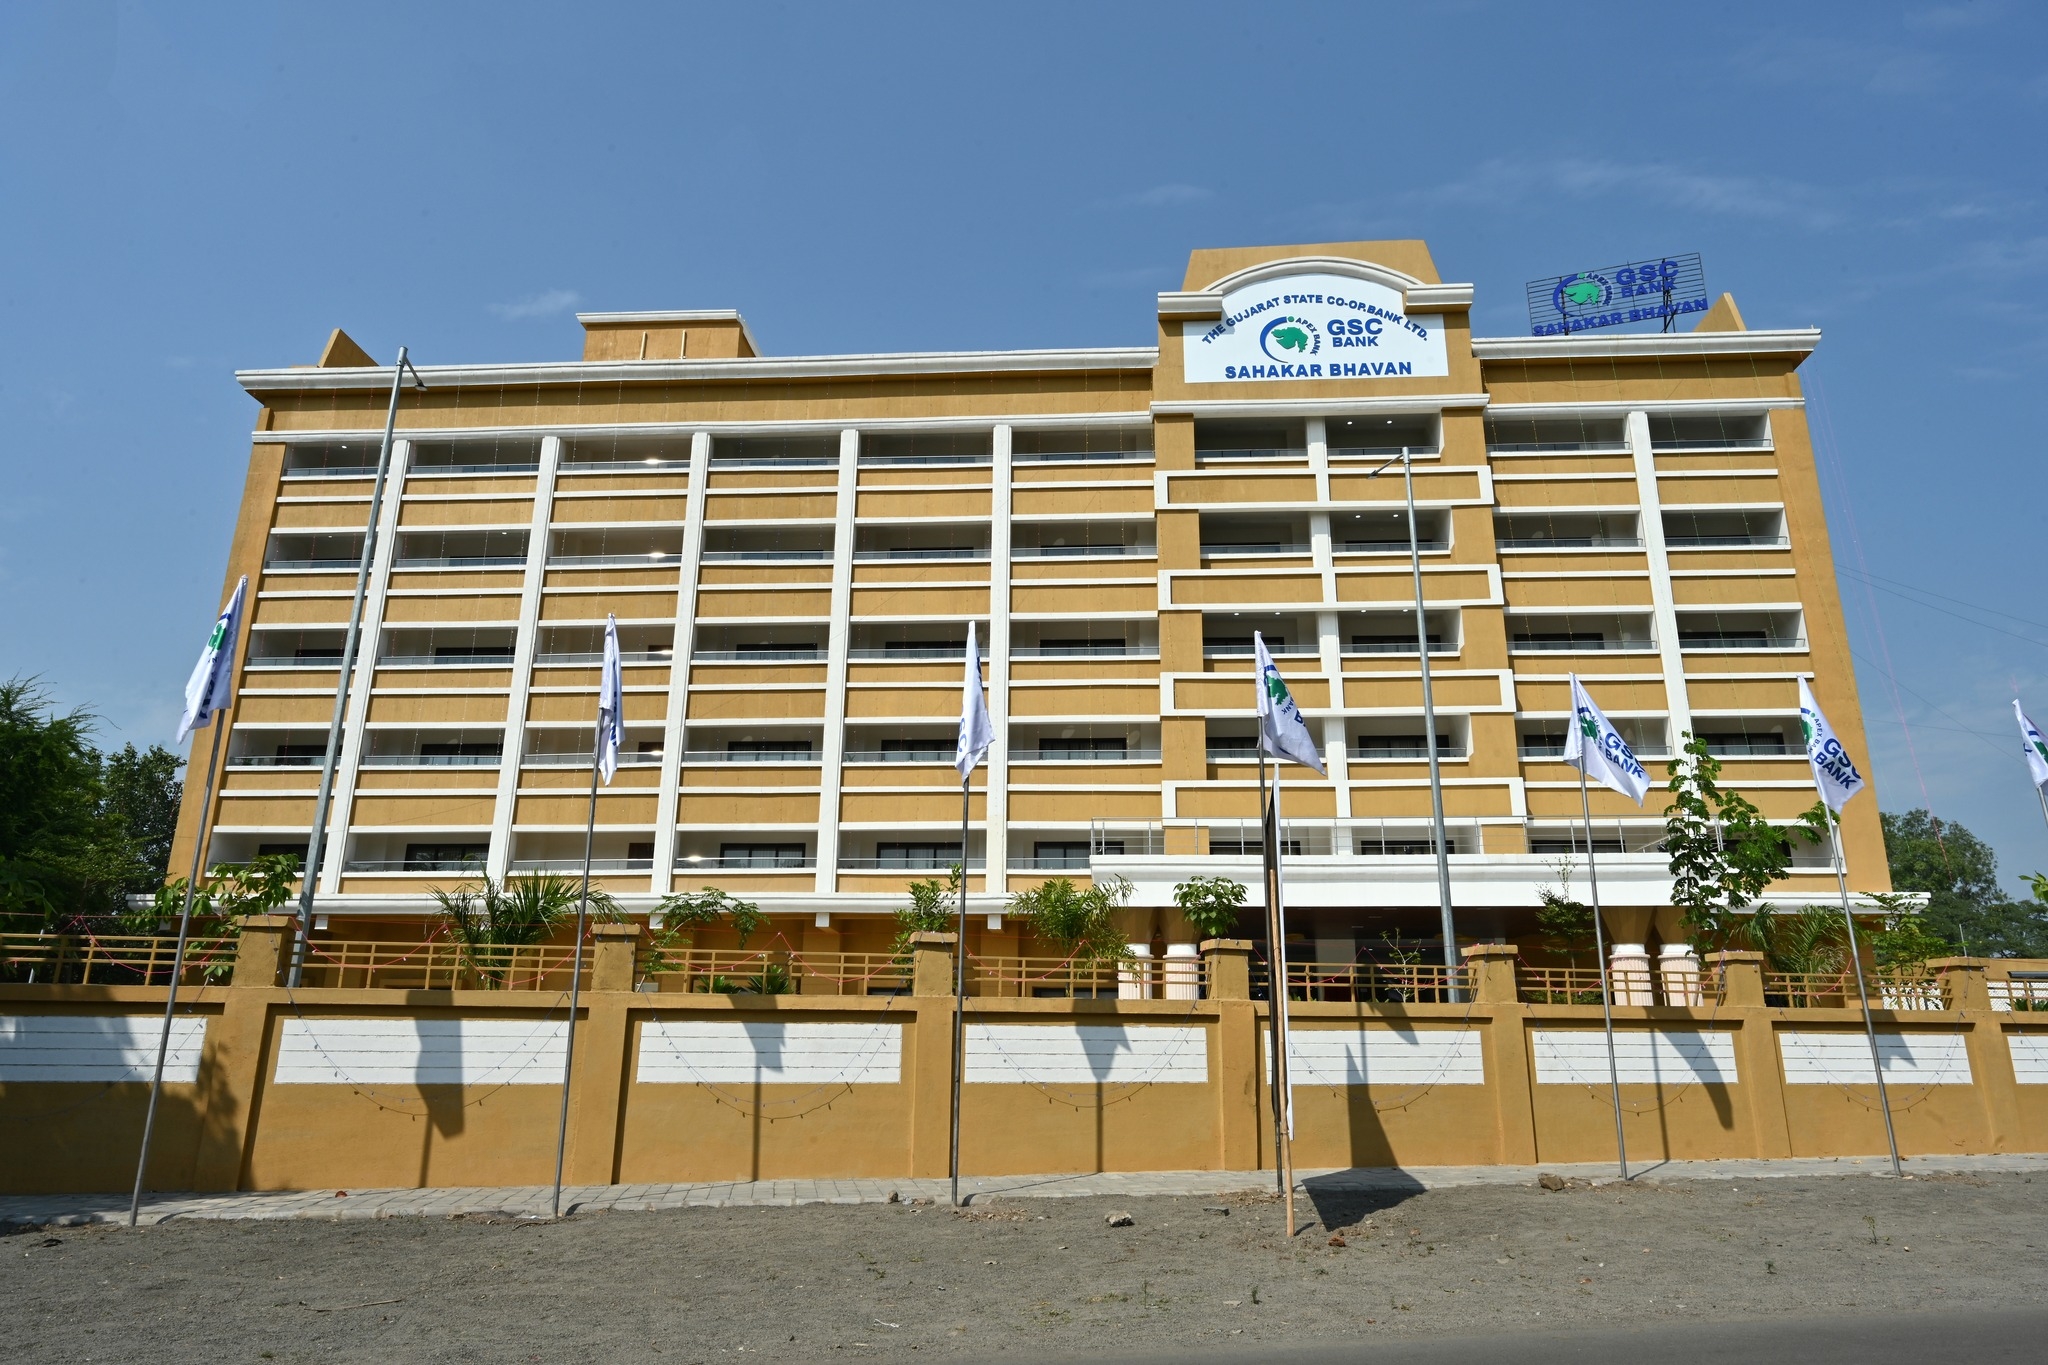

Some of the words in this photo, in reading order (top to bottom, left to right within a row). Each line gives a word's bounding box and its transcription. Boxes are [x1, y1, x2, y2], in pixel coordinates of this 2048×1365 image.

[1616, 261, 1679, 285] GSC
[1621, 278, 1678, 298] BANK
[1201, 324, 1226, 345] THE
[1225, 297, 1280, 327] GUJARAT
[1283, 294, 1323, 304] STATE
[1403, 320, 1428, 341] LTD.
[1327, 318, 1383, 336] GSC
[1533, 312, 1624, 336] SAHAKAR
[1628, 298, 1709, 323] BHAVAN
[1295, 317, 1318, 333] APEX
[1310, 334, 1321, 356] BANK
[1332, 336, 1379, 347] BANK
[1225, 364, 1323, 379] SAHAKAR
[1329, 361, 1412, 376] BHAVAN
[1814, 718, 1823, 737] APEX
[1605, 748, 1644, 779] BANK
[1814, 751, 1857, 790] BANK
